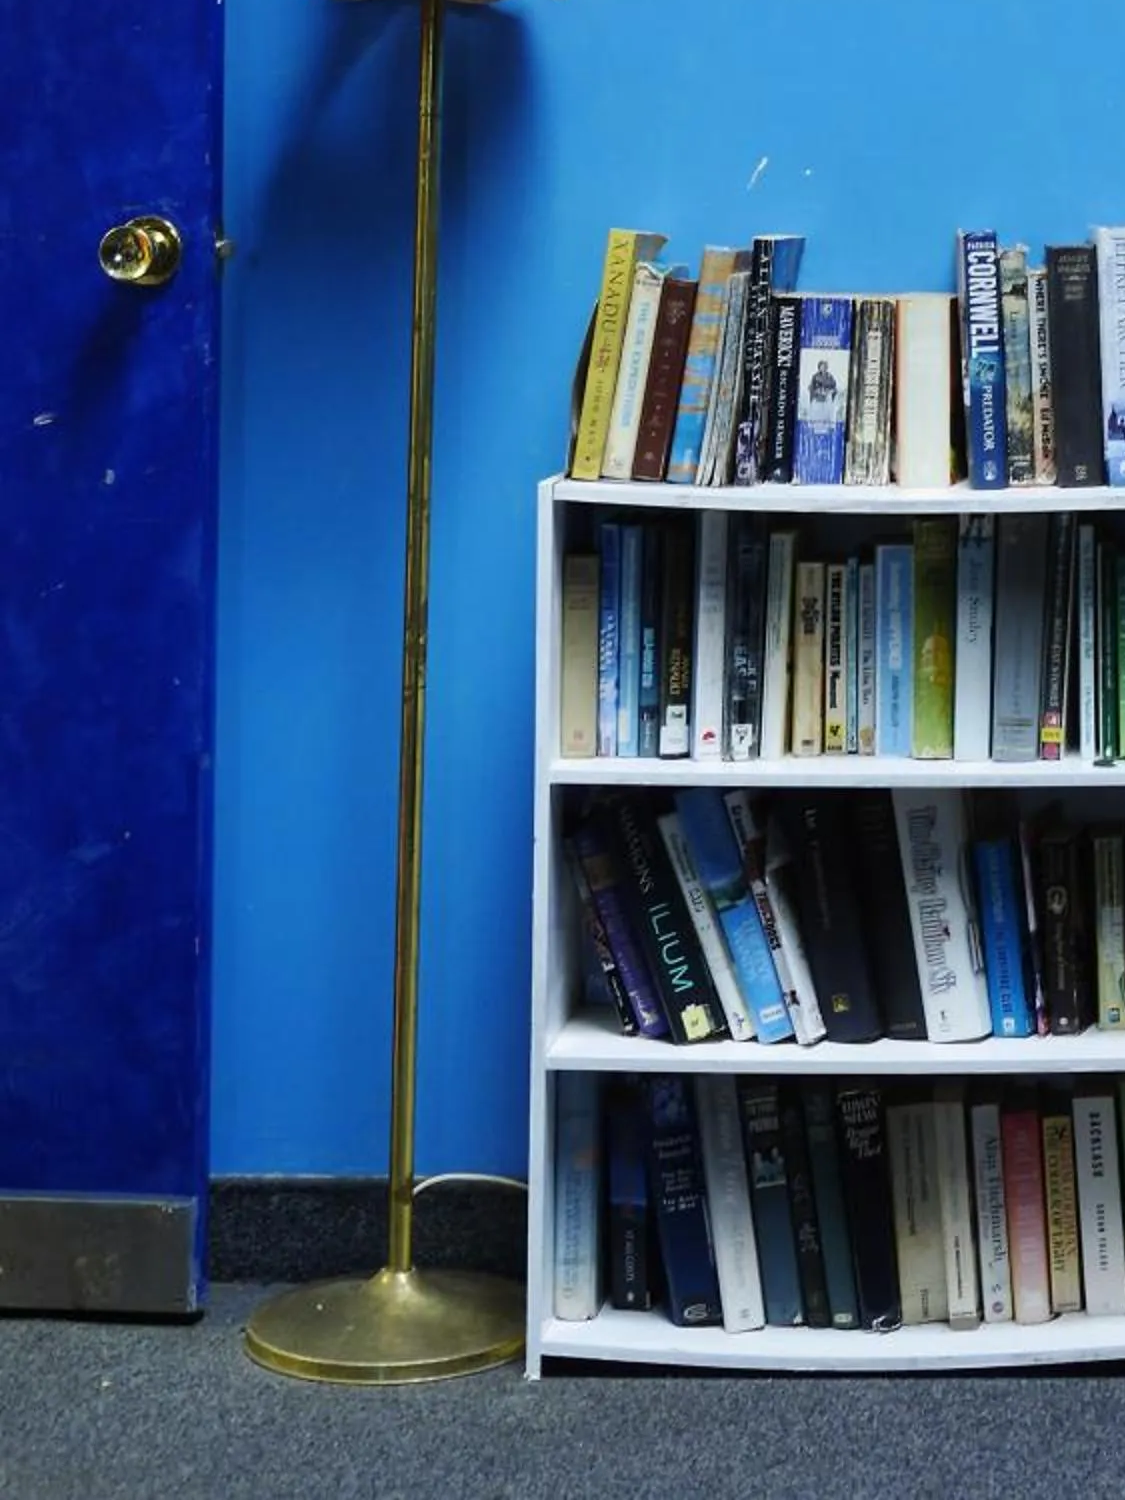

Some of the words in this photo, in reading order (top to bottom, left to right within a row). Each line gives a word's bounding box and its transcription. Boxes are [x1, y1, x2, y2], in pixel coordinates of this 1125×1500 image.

[601, 241, 629, 334] XANADU
[967, 251, 999, 359] CORNWELL
[777, 305, 794, 367] MAVERICK!
[982, 385, 995, 452] PREDATOR
[648, 903, 693, 993] ILIUM
